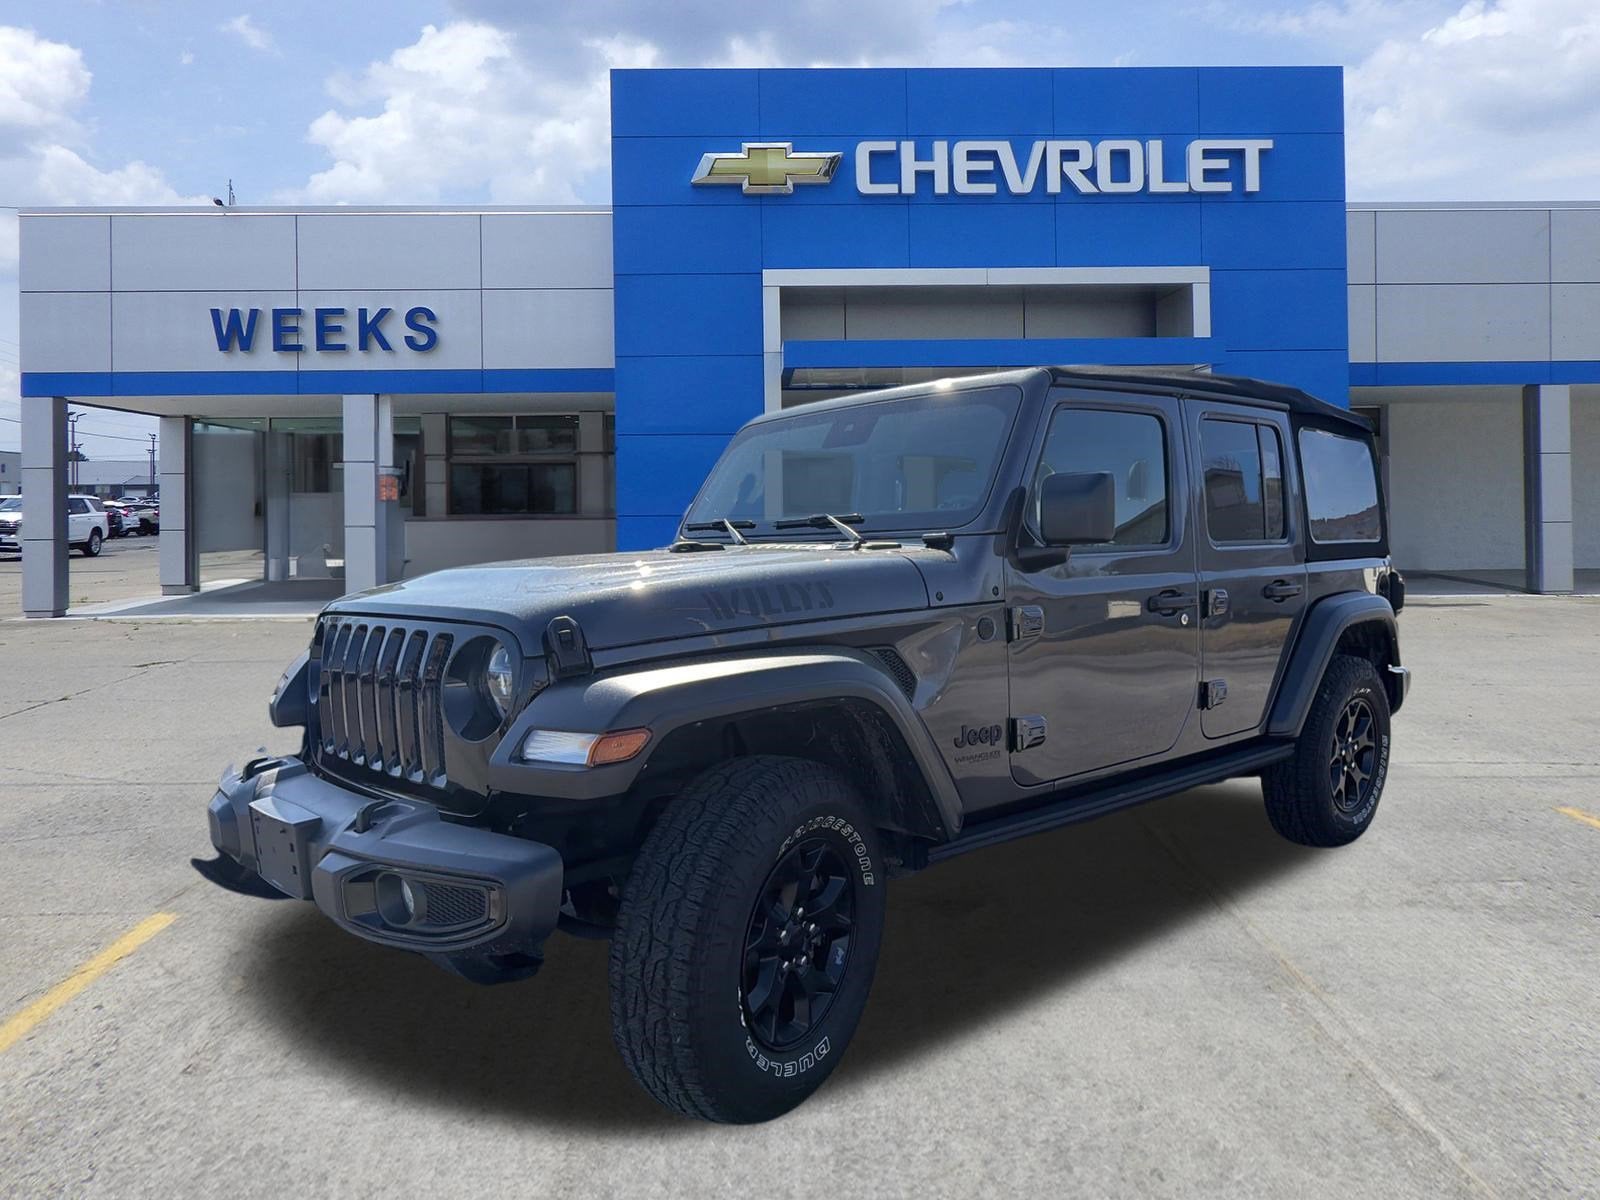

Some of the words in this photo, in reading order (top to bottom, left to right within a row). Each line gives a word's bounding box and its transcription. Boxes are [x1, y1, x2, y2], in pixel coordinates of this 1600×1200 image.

[855, 139, 1274, 194] CHEVROLET
[210, 306, 438, 352] WEEKS
[700, 580, 835, 620] WILLYS
[954, 723, 1002, 749] Jeep
[745, 1035, 831, 1077] DUELER
